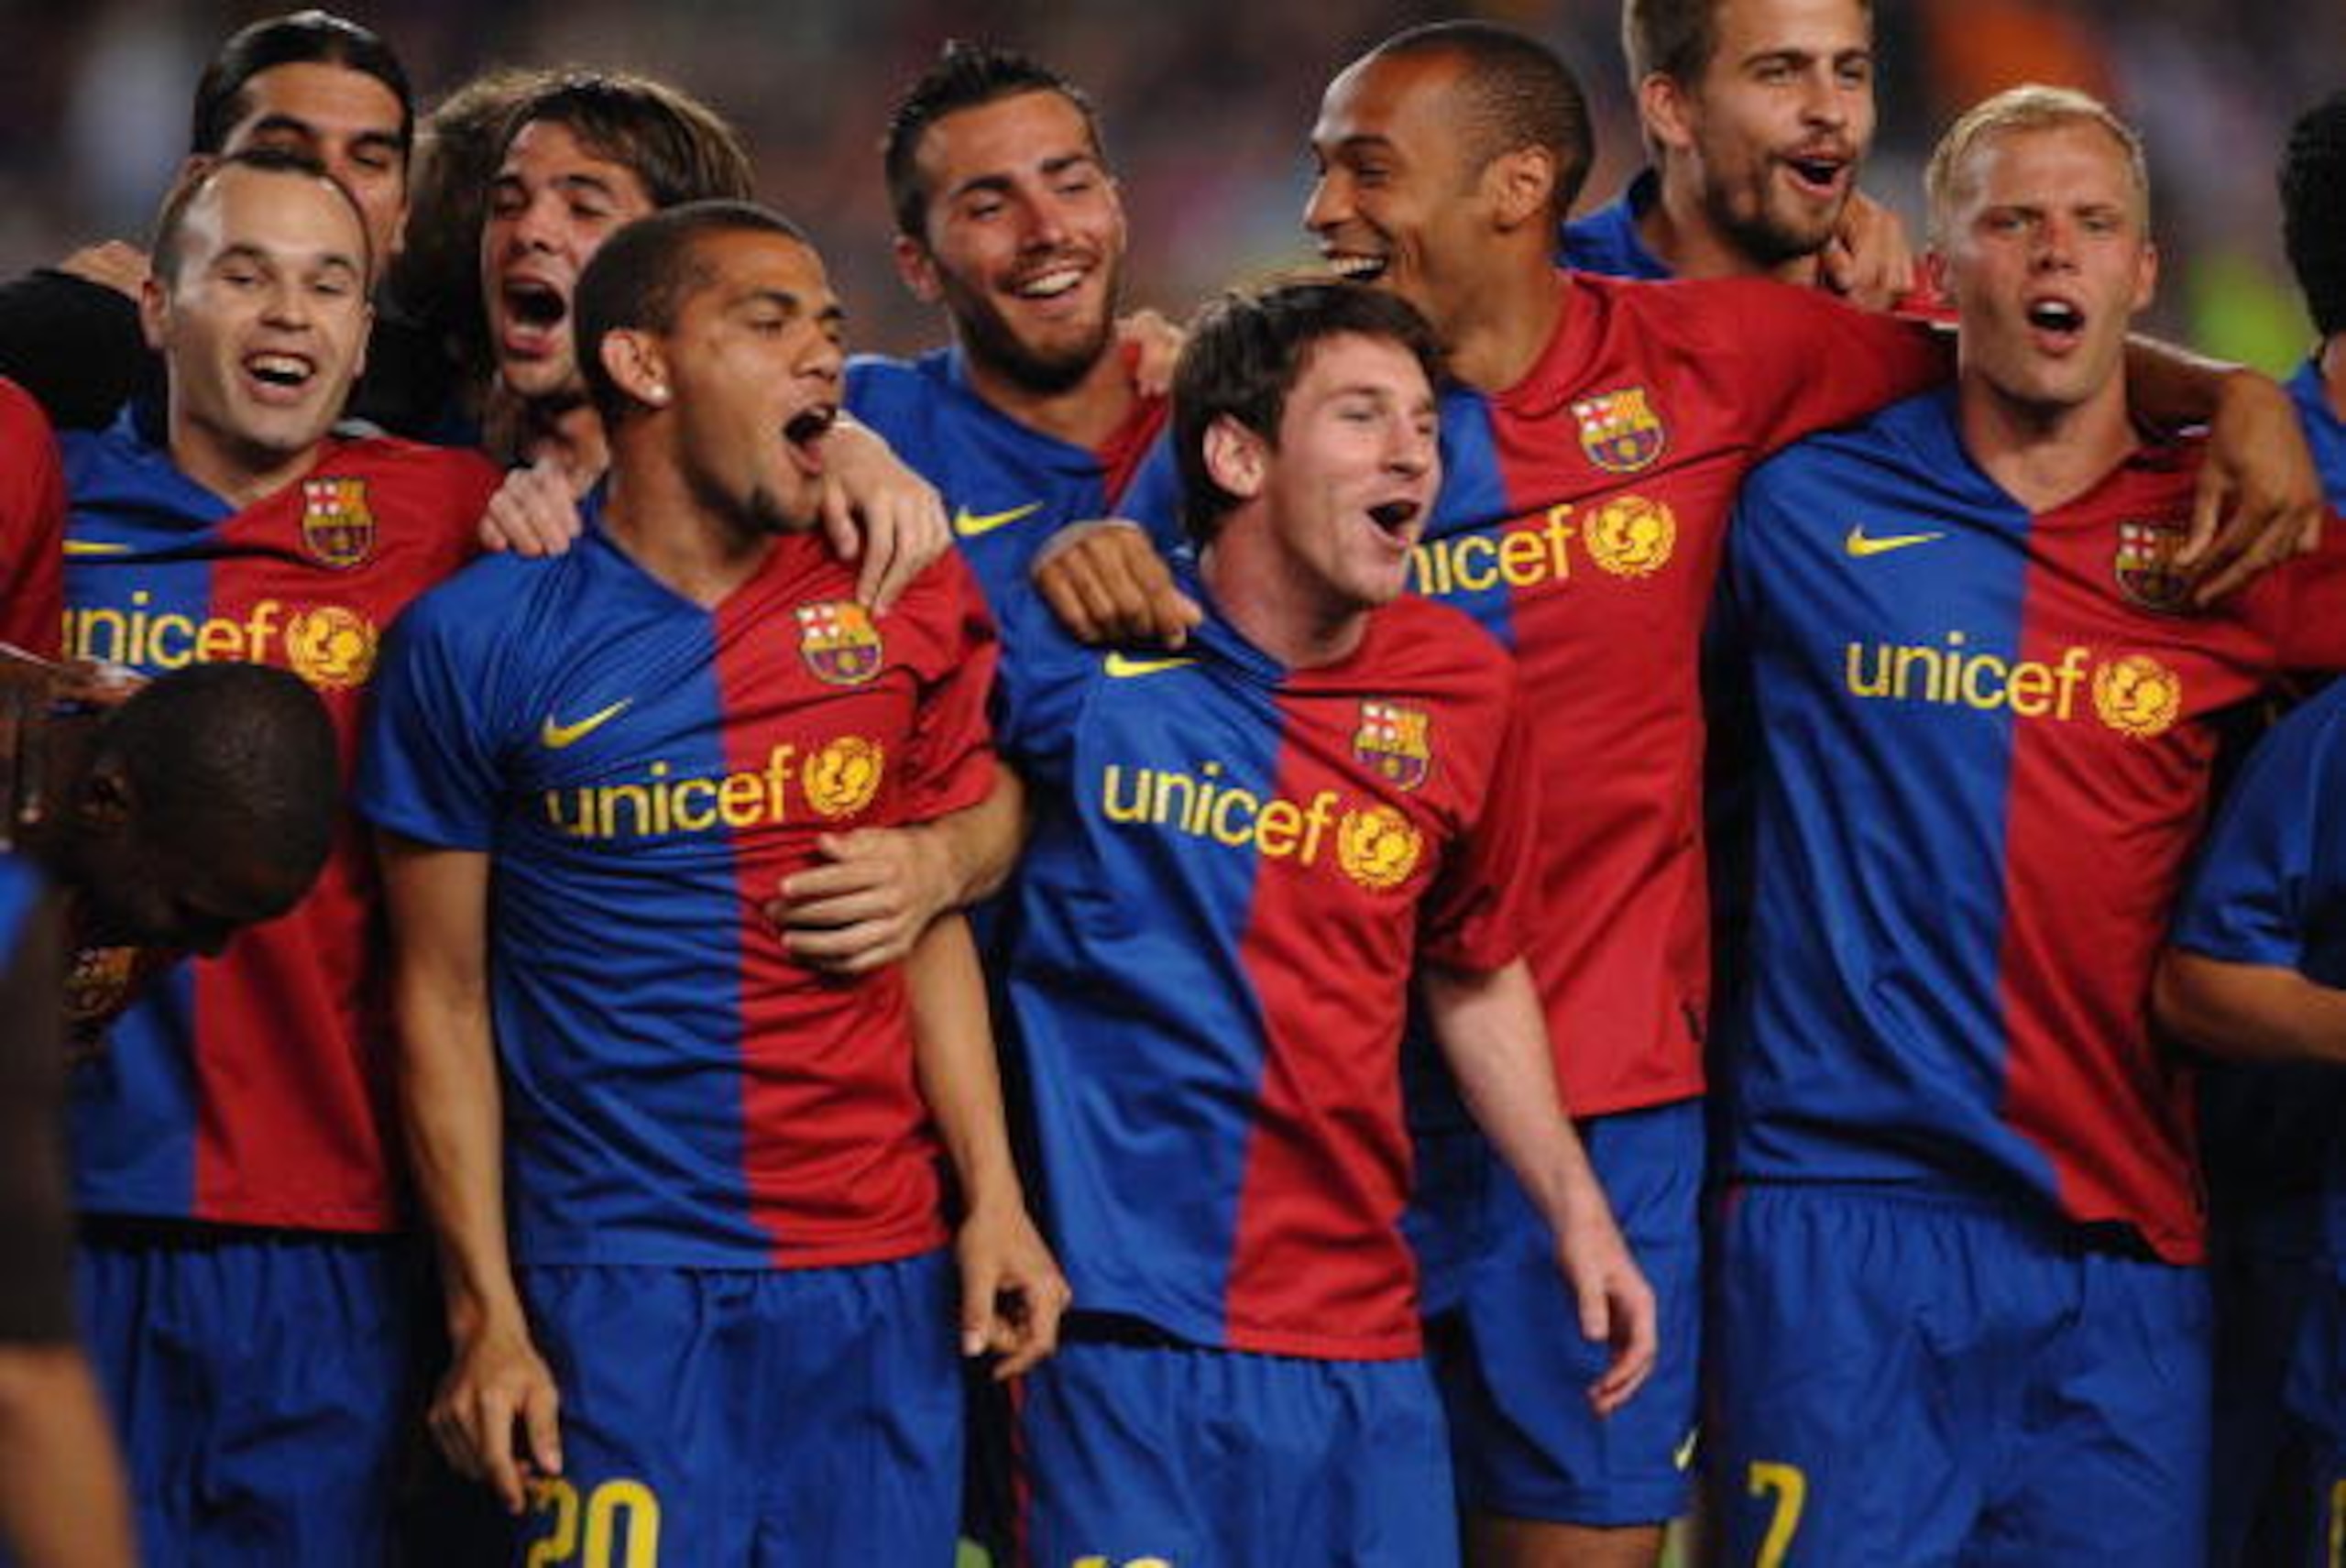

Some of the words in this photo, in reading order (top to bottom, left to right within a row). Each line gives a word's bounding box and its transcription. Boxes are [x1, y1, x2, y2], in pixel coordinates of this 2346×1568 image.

[1846, 631, 2088, 719] unicef
[547, 745, 793, 837] unicef
[1104, 762, 1337, 864] unicef
[528, 1478, 660, 1568] 20
